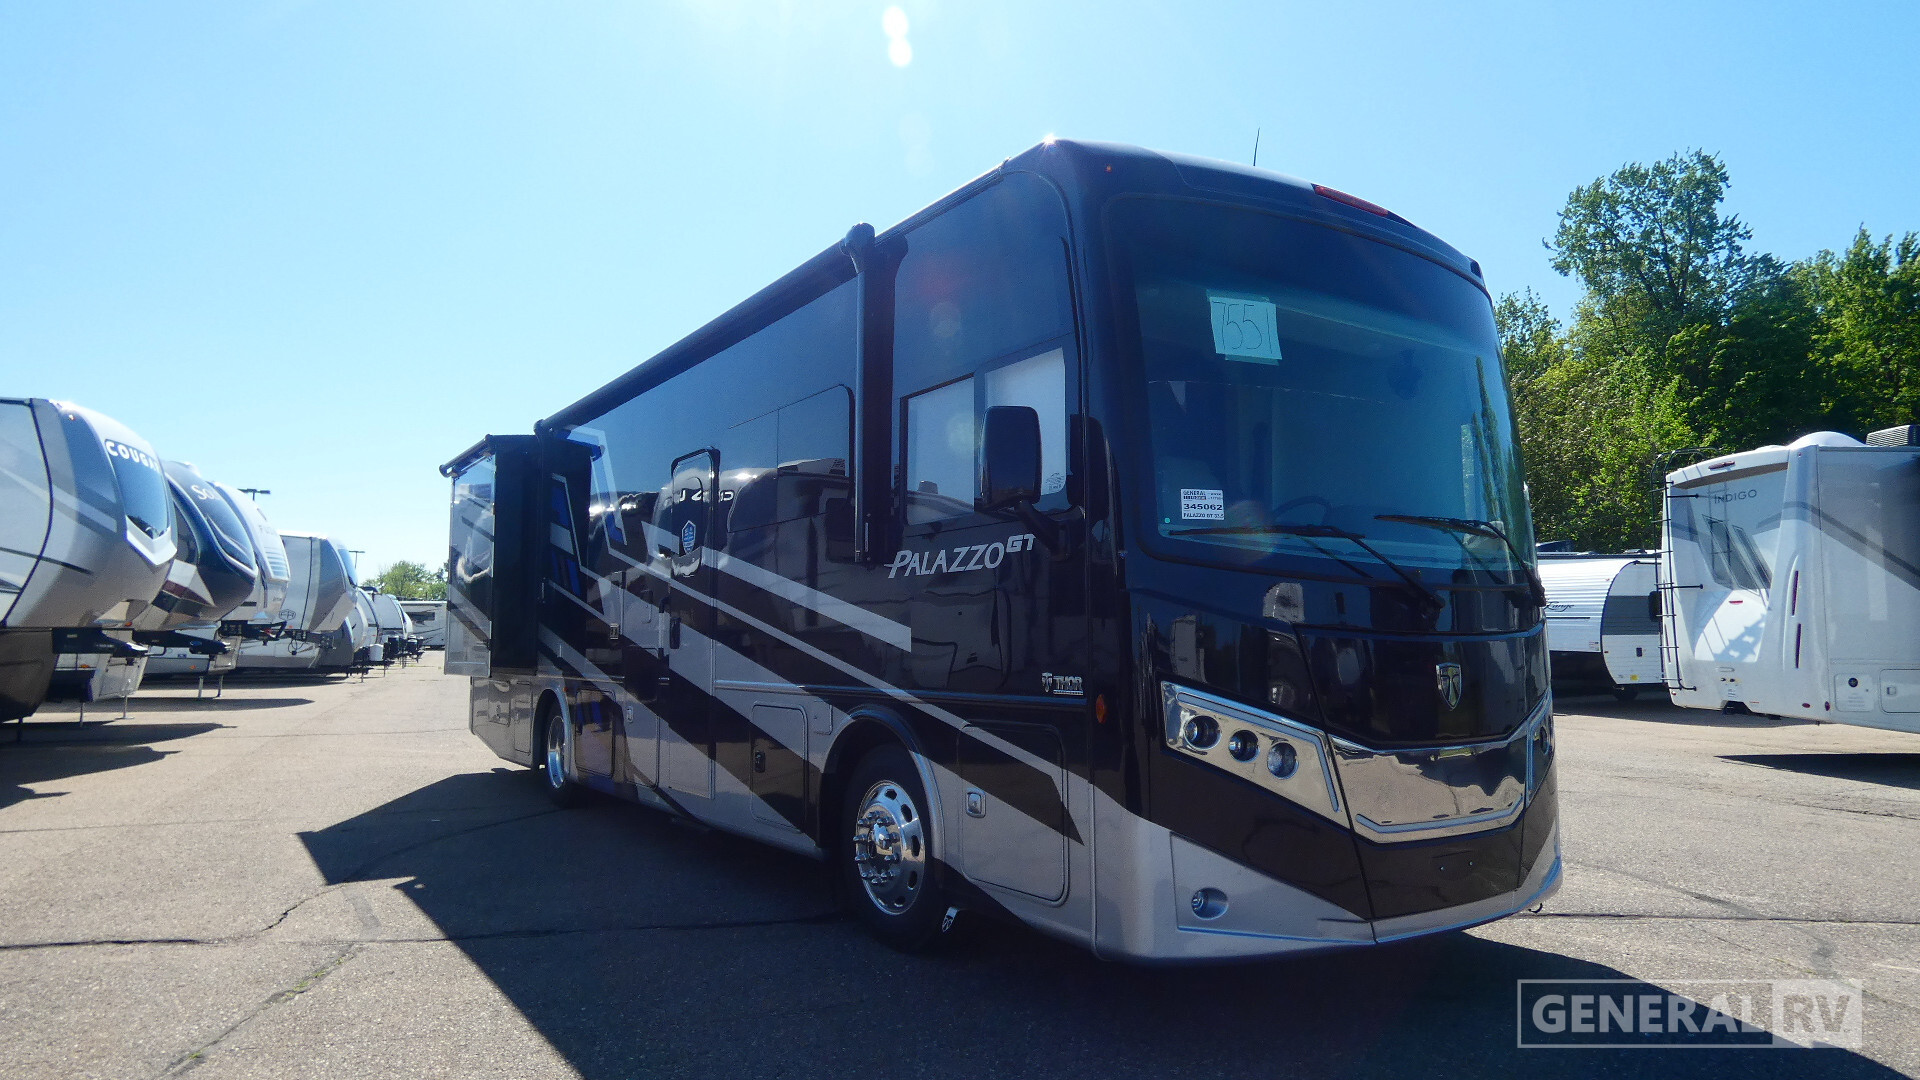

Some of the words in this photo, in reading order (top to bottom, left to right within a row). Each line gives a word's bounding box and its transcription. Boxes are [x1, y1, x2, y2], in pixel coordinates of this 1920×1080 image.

[1211, 300, 1273, 355] 7551
[1714, 489, 1758, 504] INDIGO
[1183, 503, 1223, 511] 345062
[883, 542, 1005, 579] PALAZZO
[1005, 533, 1037, 553] GT
[1053, 675, 1083, 691] THOR
